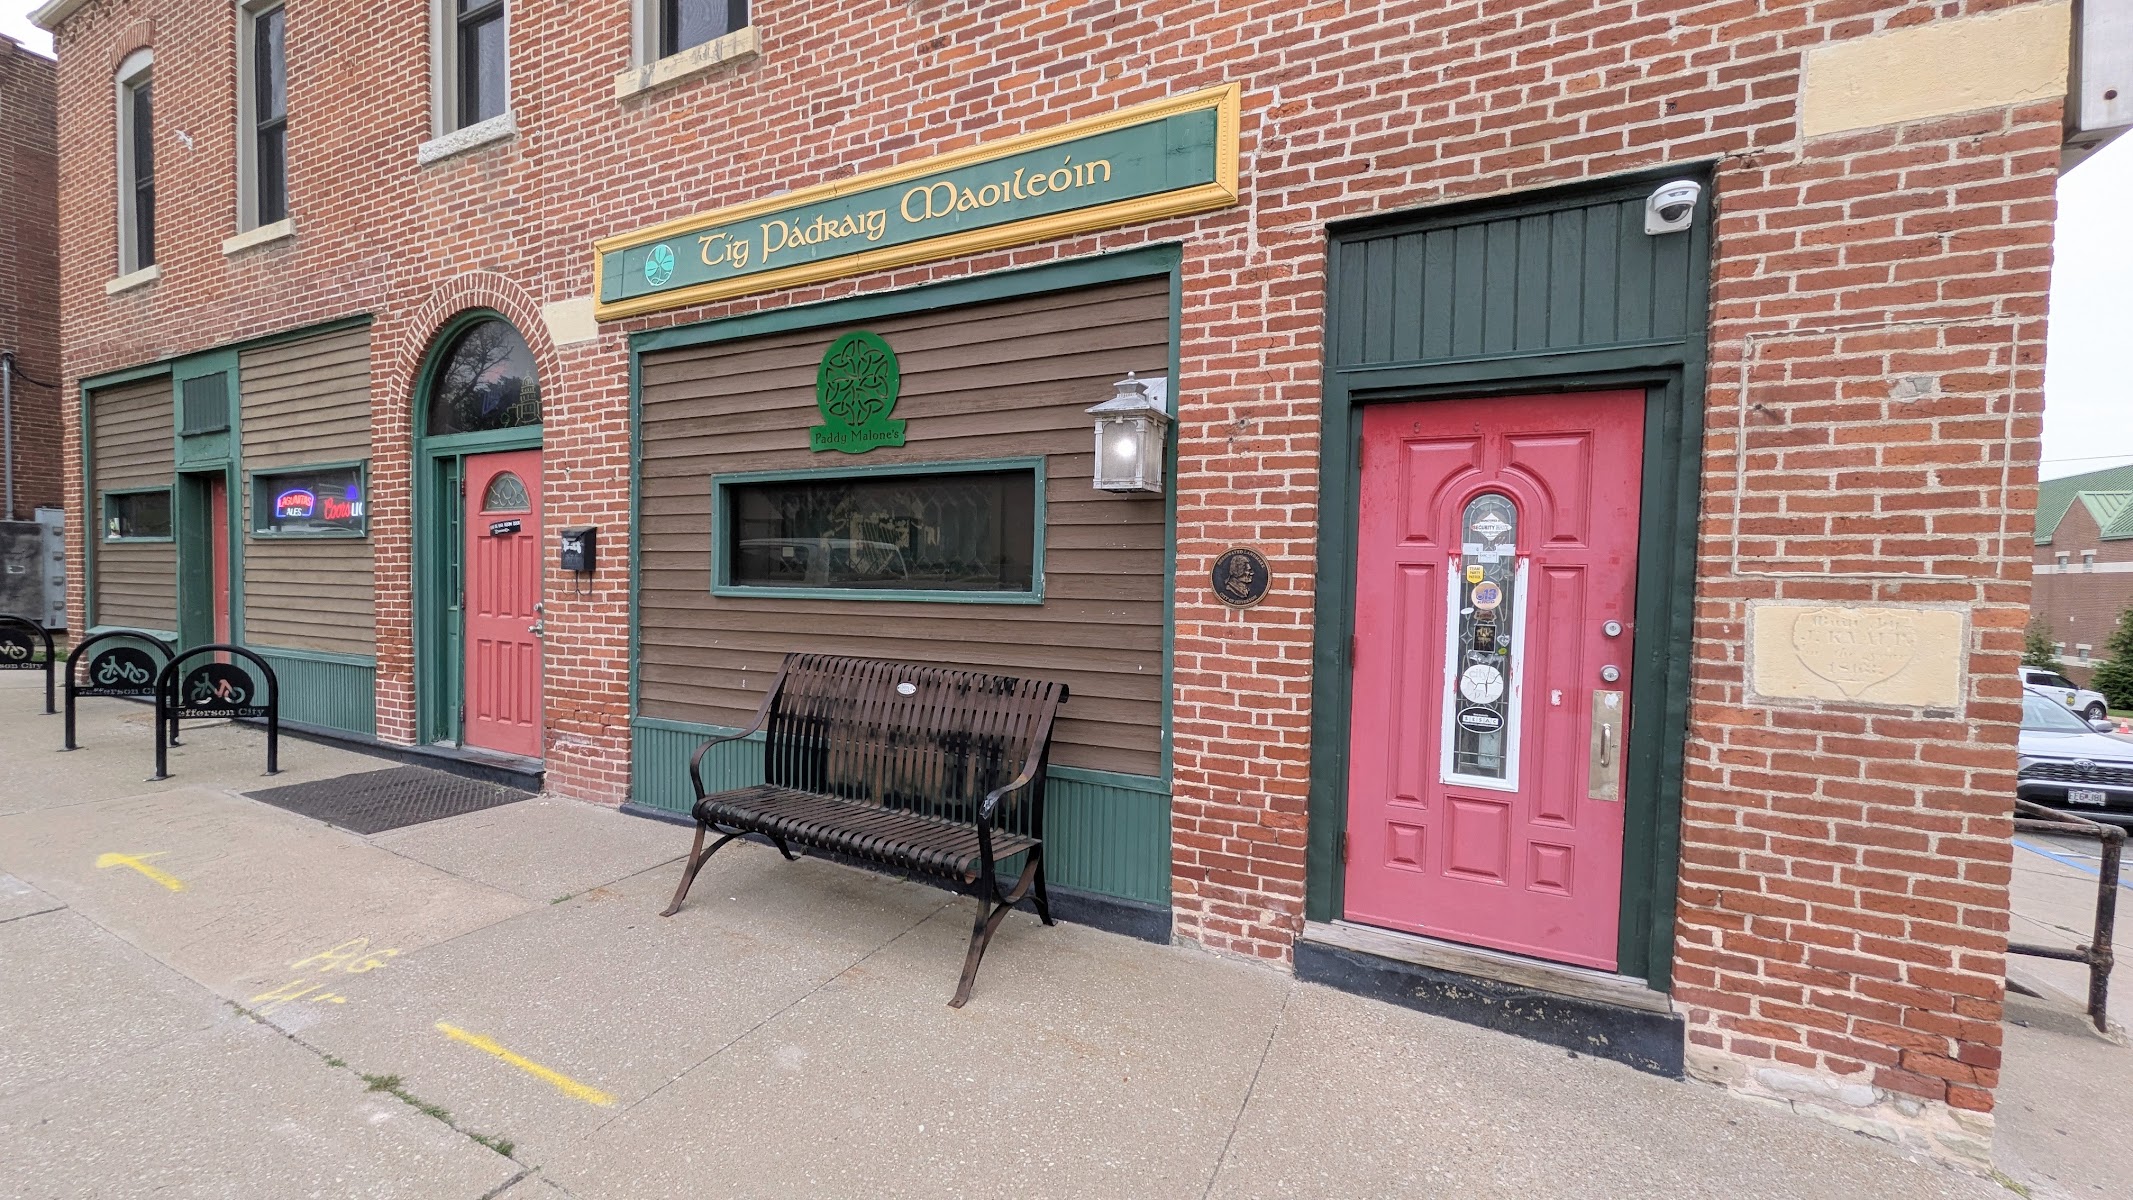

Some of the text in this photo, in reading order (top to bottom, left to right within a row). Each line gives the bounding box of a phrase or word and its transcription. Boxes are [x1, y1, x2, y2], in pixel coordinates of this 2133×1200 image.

[760, 208, 887, 264] Pádraig
[900, 155, 1112, 223] Maoileóin
[815, 429, 899, 444] Paddy Malone's
[286, 507, 303, 517] ALES
[324, 497, 350, 519] Coors
[1484, 588, 1497, 600] 13
[21, 662, 43, 670] City
[142, 687, 156, 695] Ci
[177, 707, 265, 718] efferson City
